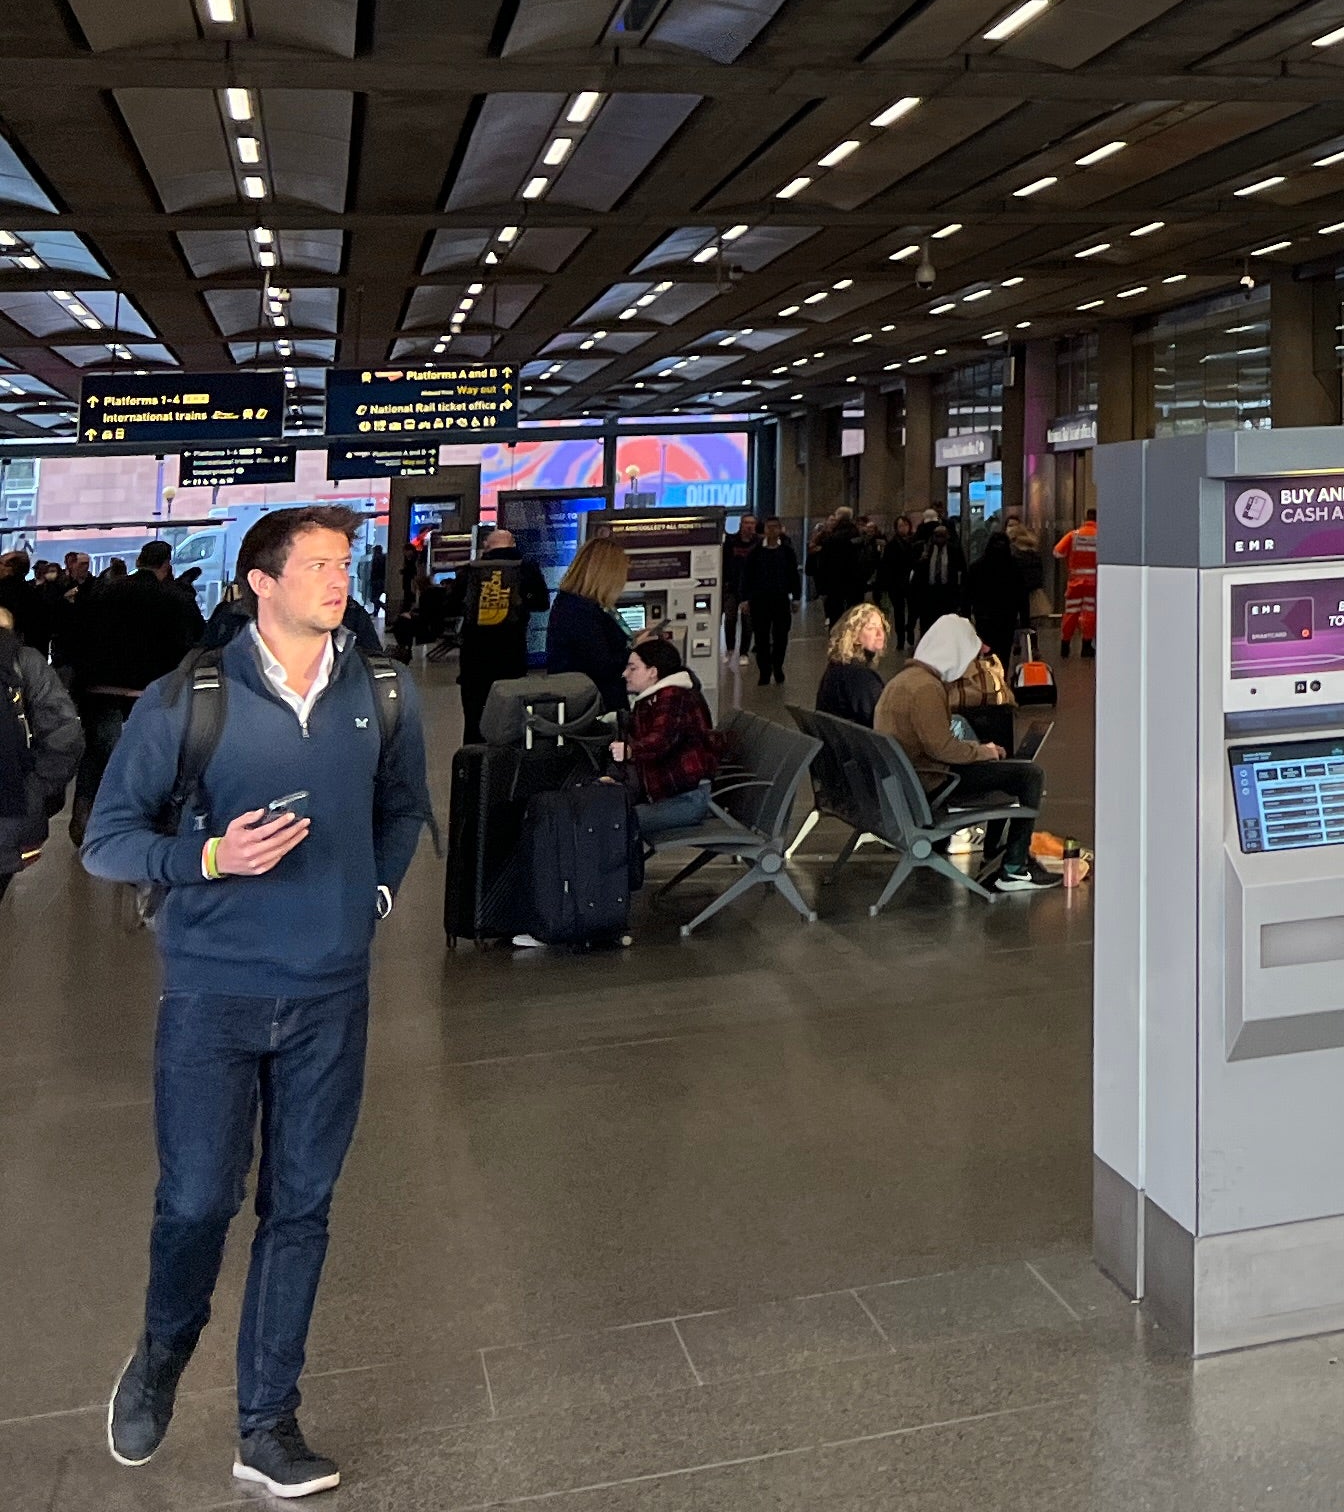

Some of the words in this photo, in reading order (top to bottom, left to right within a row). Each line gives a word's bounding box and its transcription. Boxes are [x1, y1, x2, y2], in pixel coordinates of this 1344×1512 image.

[406, 369, 457, 381] Platforms
[468, 368, 488, 379] and
[104, 395, 159, 406] Platforms
[161, 394, 180, 405] 1-4
[369, 403, 414, 415] National
[415, 402, 436, 413] Rail
[437, 401, 467, 412] ticket
[468, 400, 497, 411] office
[102, 411, 173, 423] International
[175, 410, 208, 421] trains
[1281, 488, 1315, 505] BUY
[1280, 506, 1329, 524] CASH
